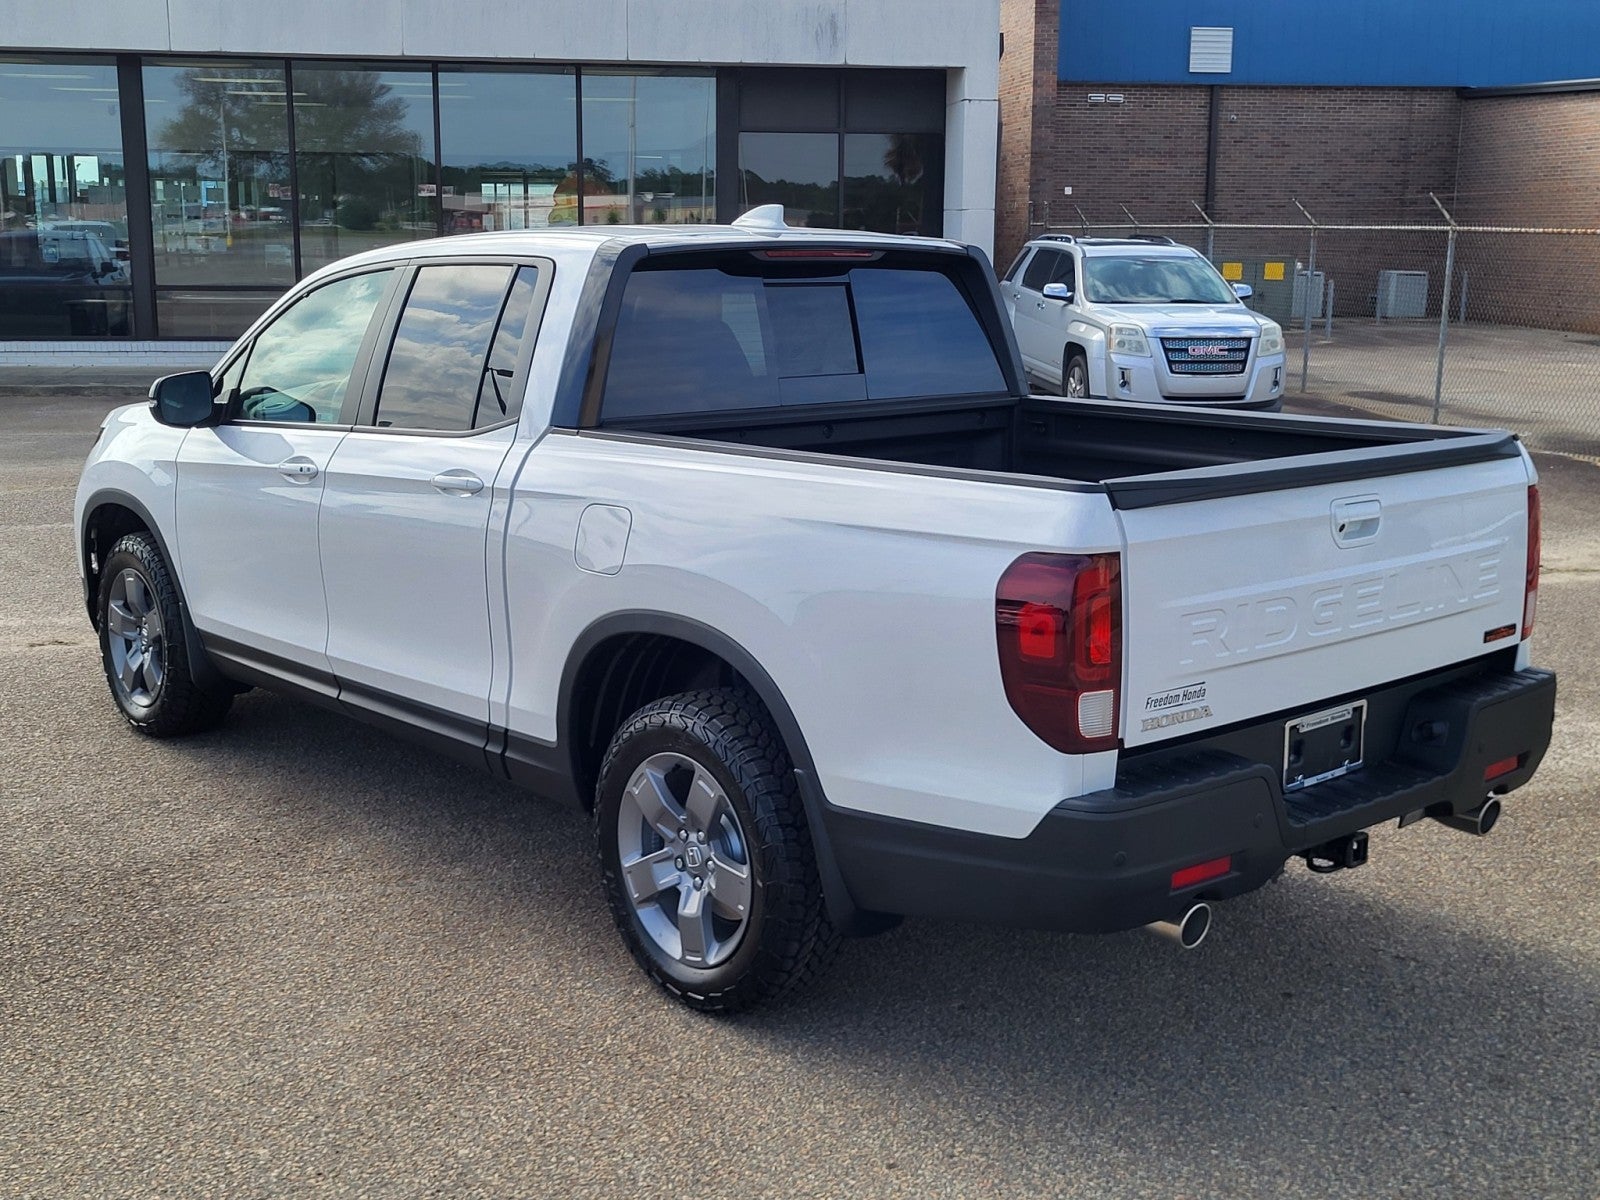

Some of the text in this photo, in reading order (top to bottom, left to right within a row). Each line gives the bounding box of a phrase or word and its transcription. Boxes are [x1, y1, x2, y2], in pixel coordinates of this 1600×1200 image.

[1188, 345, 1228, 356] GMC
[1180, 551, 1500, 664] RIDGELINE
[1145, 686, 1207, 710] Freedom Honda
[1141, 705, 1213, 732] HONDA
